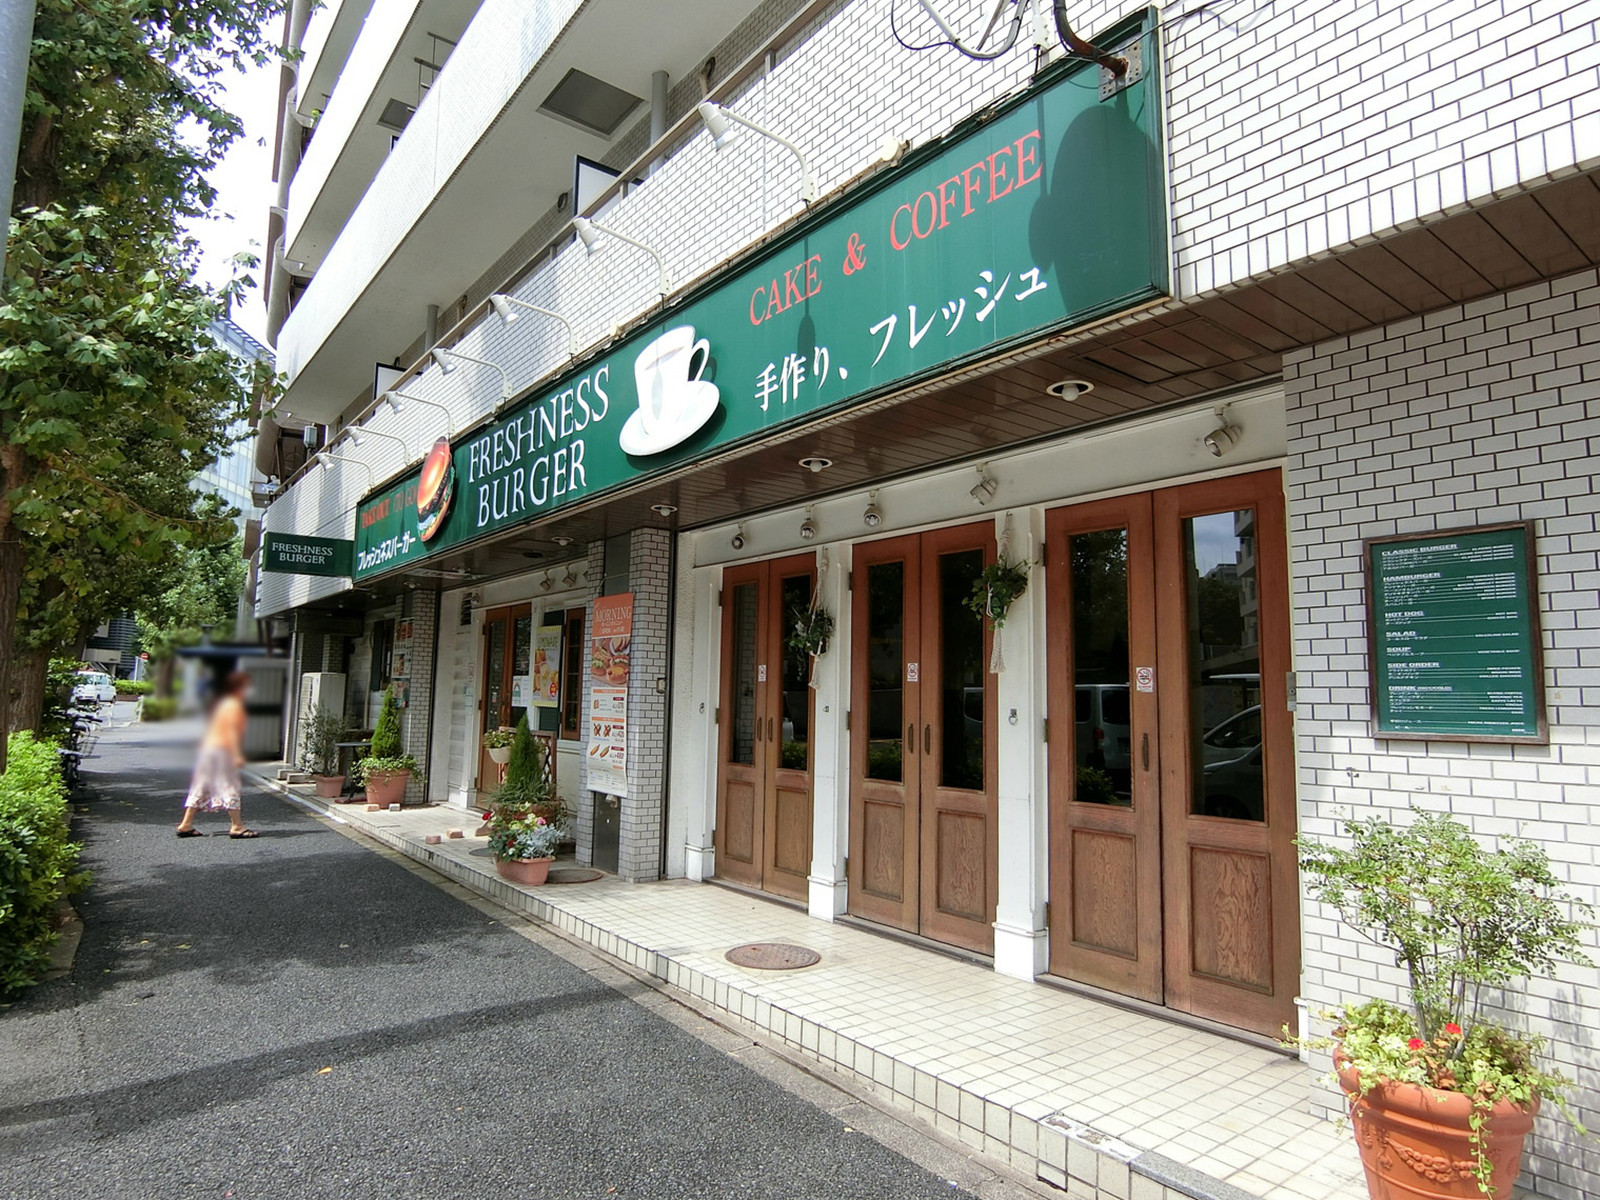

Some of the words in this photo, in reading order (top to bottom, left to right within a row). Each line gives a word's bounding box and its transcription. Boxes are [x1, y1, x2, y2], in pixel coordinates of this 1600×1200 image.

[750, 254, 822, 326] CAKE
[842, 232, 867, 276] &
[890, 129, 1043, 251] COFFEE
[468, 364, 609, 483] FRESHNESS
[477, 439, 586, 527] BURGER
[271, 542, 333, 556] FRESHNESS
[1381, 547, 1419, 557] CLASSIC
[1419, 543, 1458, 552] BURGER
[279, 552, 326, 565] BURGER
[1382, 572, 1441, 583] HAMBURGER
